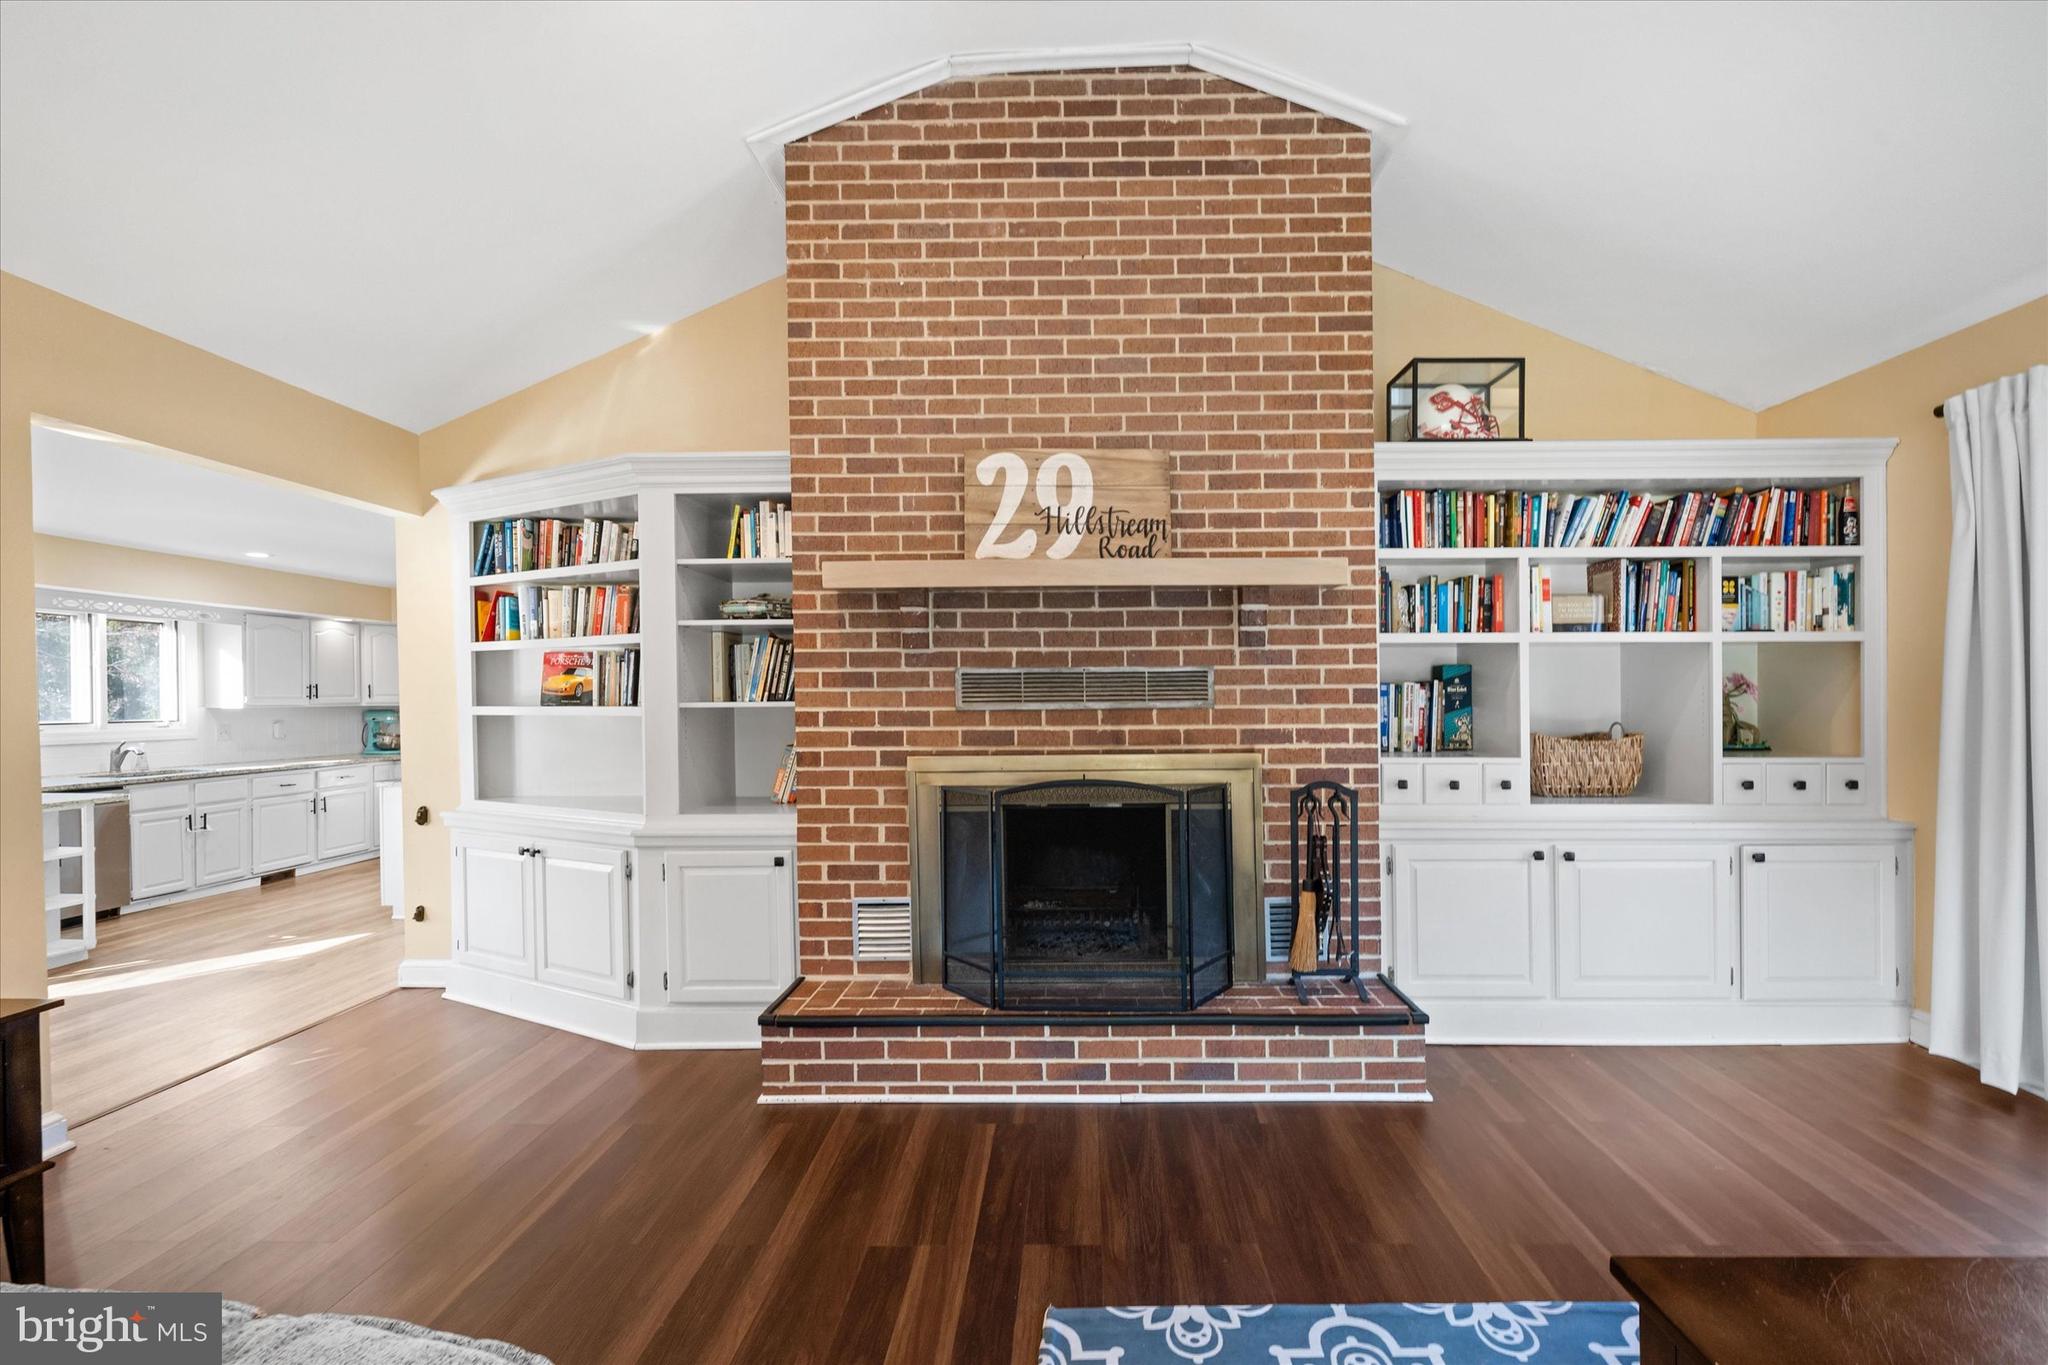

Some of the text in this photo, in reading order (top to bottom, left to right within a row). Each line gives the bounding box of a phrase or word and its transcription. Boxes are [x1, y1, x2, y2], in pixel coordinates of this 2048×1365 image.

[975, 452, 1093, 559] 29
[1034, 505, 1168, 543] Hillstream
[1099, 534, 1160, 559] Road
